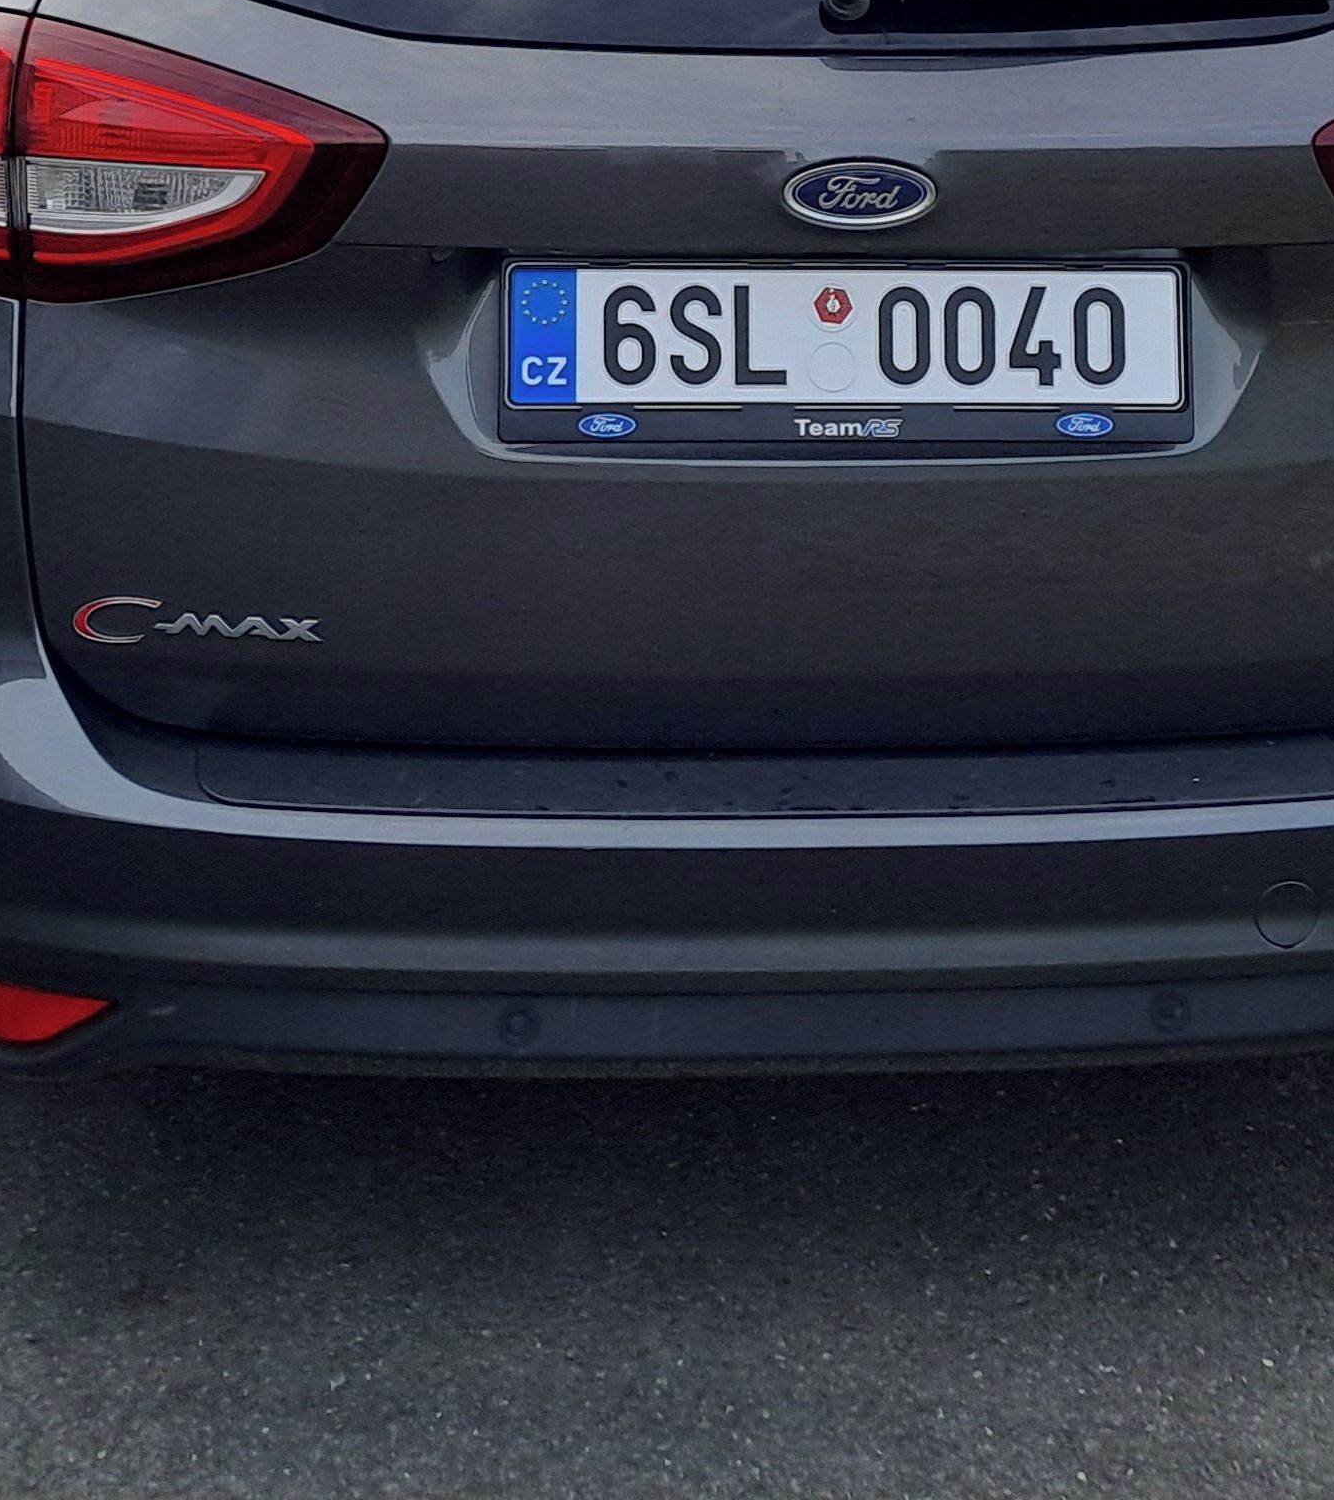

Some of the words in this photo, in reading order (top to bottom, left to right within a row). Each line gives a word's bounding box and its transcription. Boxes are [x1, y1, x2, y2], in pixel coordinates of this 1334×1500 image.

[818, 174, 901, 210] Ford
[521, 355, 568, 386] CZ
[603, 285, 787, 386] 6SL
[878, 286, 1126, 386] 0040
